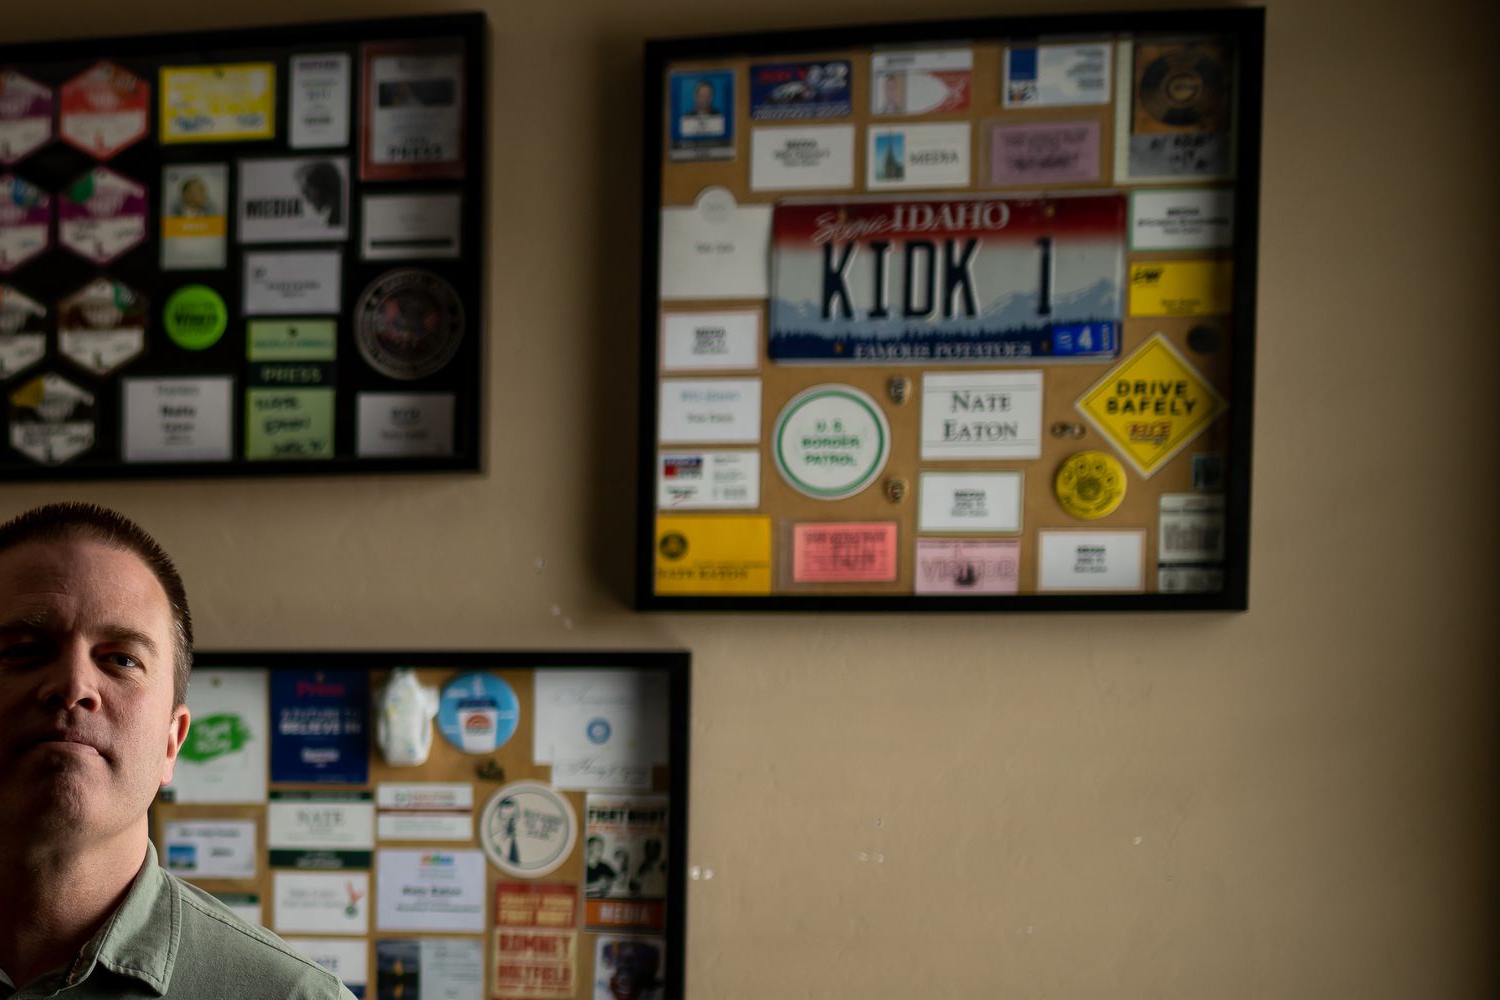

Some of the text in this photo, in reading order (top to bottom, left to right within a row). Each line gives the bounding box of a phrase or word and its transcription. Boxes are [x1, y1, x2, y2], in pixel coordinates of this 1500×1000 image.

[247, 199, 303, 219] MEDIA
[892, 201, 1011, 232] IDAHO
[821, 238, 1052, 319] KIDK 1
[1076, 326, 1093, 351] 4
[852, 344, 932, 361] FAMOUS
[938, 340, 1033, 358] POTATOES
[261, 367, 323, 383] PRESS
[1116, 379, 1188, 398] DRIVE
[951, 391, 1013, 413] NATE
[1106, 398, 1198, 416] SAFELY
[942, 419, 1018, 441] EATON
[801, 437, 860, 448] BORDER
[803, 454, 857, 467] PATROL
